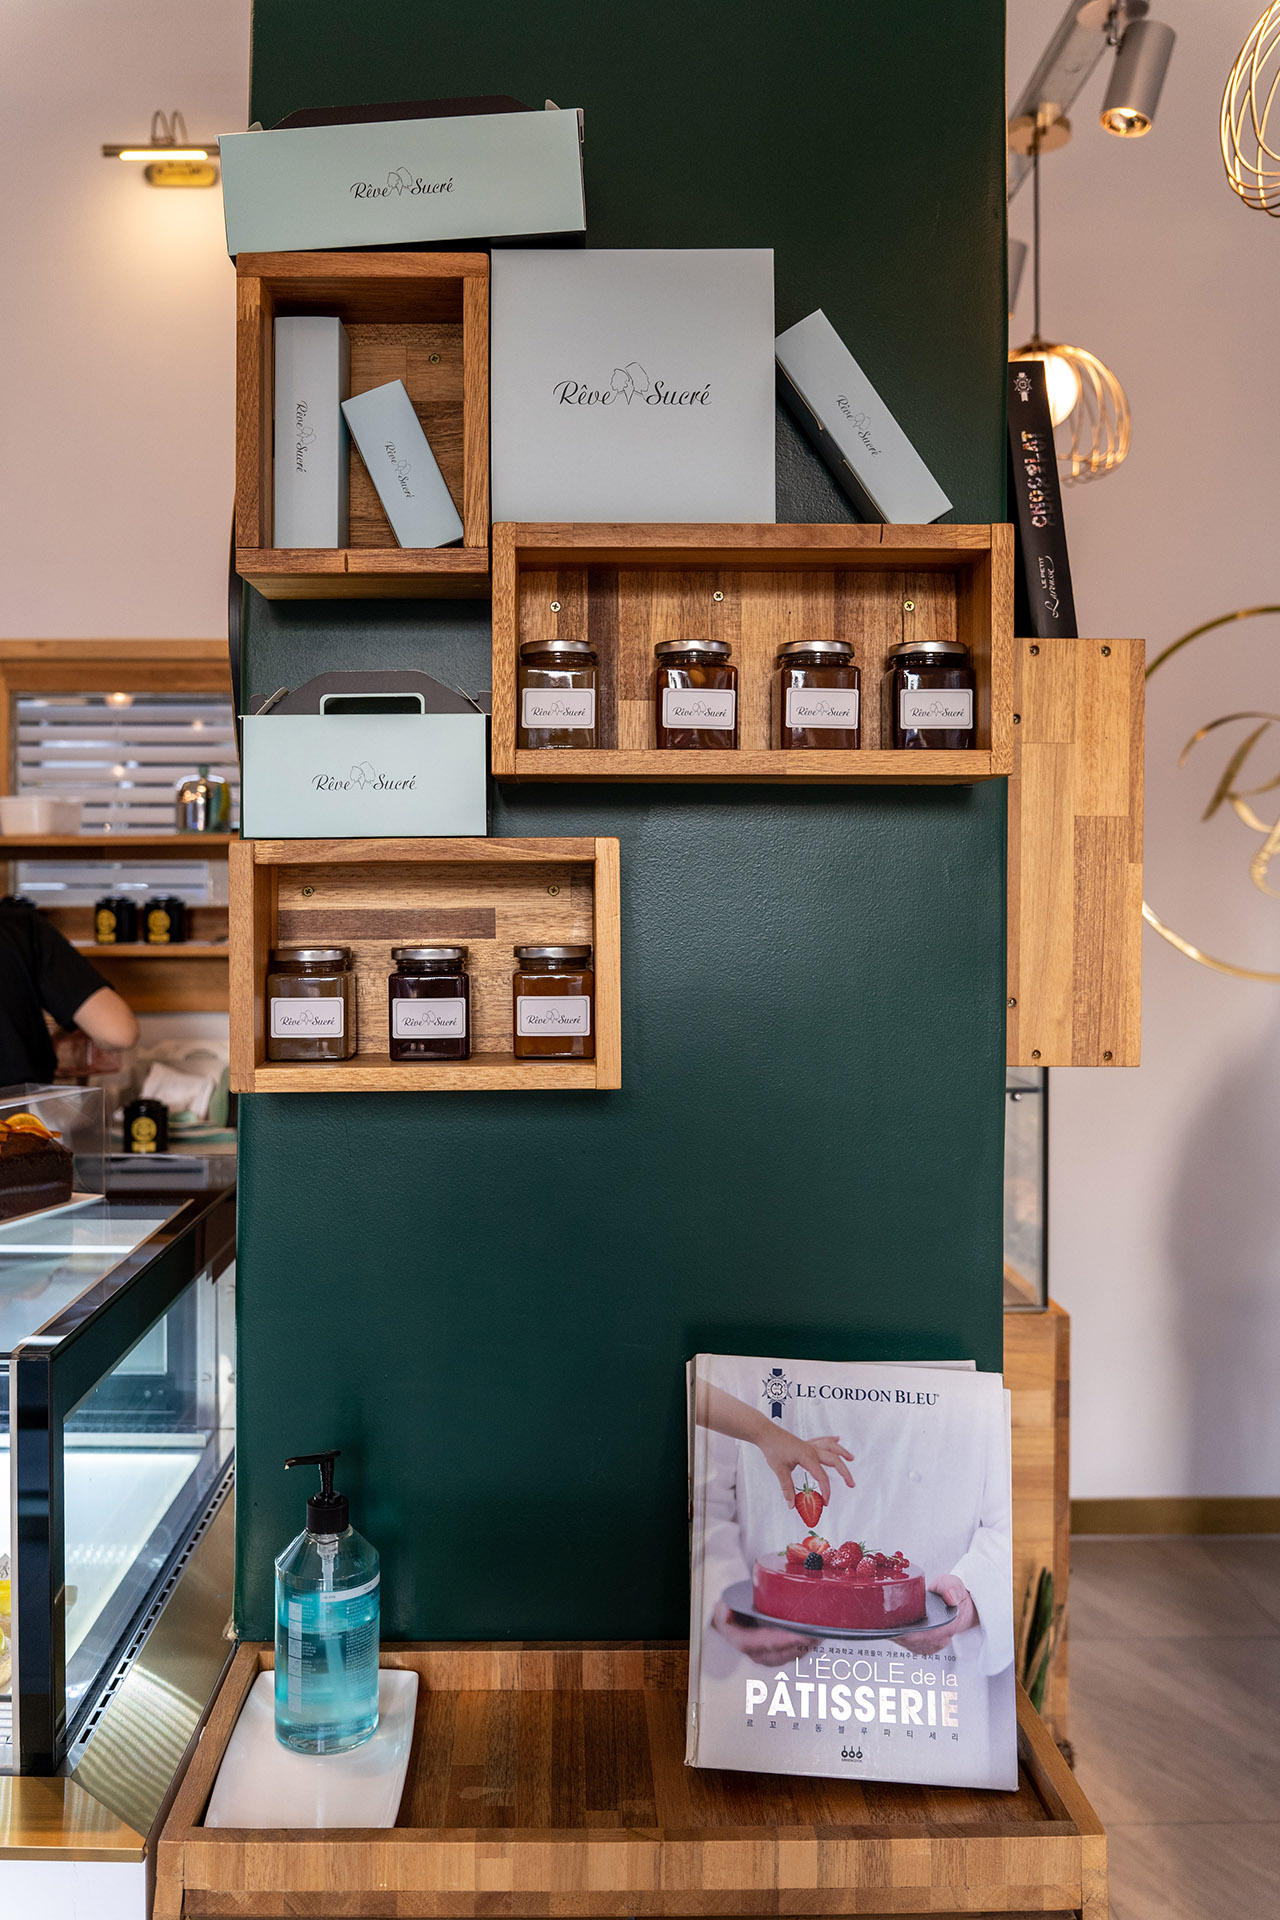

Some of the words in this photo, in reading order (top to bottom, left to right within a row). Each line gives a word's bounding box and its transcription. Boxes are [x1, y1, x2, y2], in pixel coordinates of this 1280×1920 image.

[349, 181, 390, 199] Rêve
[410, 177, 455, 195] Sucré
[553, 380, 614, 406] Rêve
[645, 380, 713, 406] Sucré
[295, 399, 308, 430] Rêve
[857, 430, 882, 457] Sucré
[295, 441, 308, 474] Sucré
[1020, 430, 1048, 529] CHOCOLAT
[1038, 556, 1046, 578] PETIT
[311, 773, 352, 791] Rêve
[372, 773, 417, 791] Sucré
[796, 1383, 816, 1399] LE
[819, 1385, 891, 1403] CORDON
[911, 1668, 937, 1686] de
[941, 1670, 959, 1687] la
[745, 1671, 960, 1728] PÂTISSERIE
